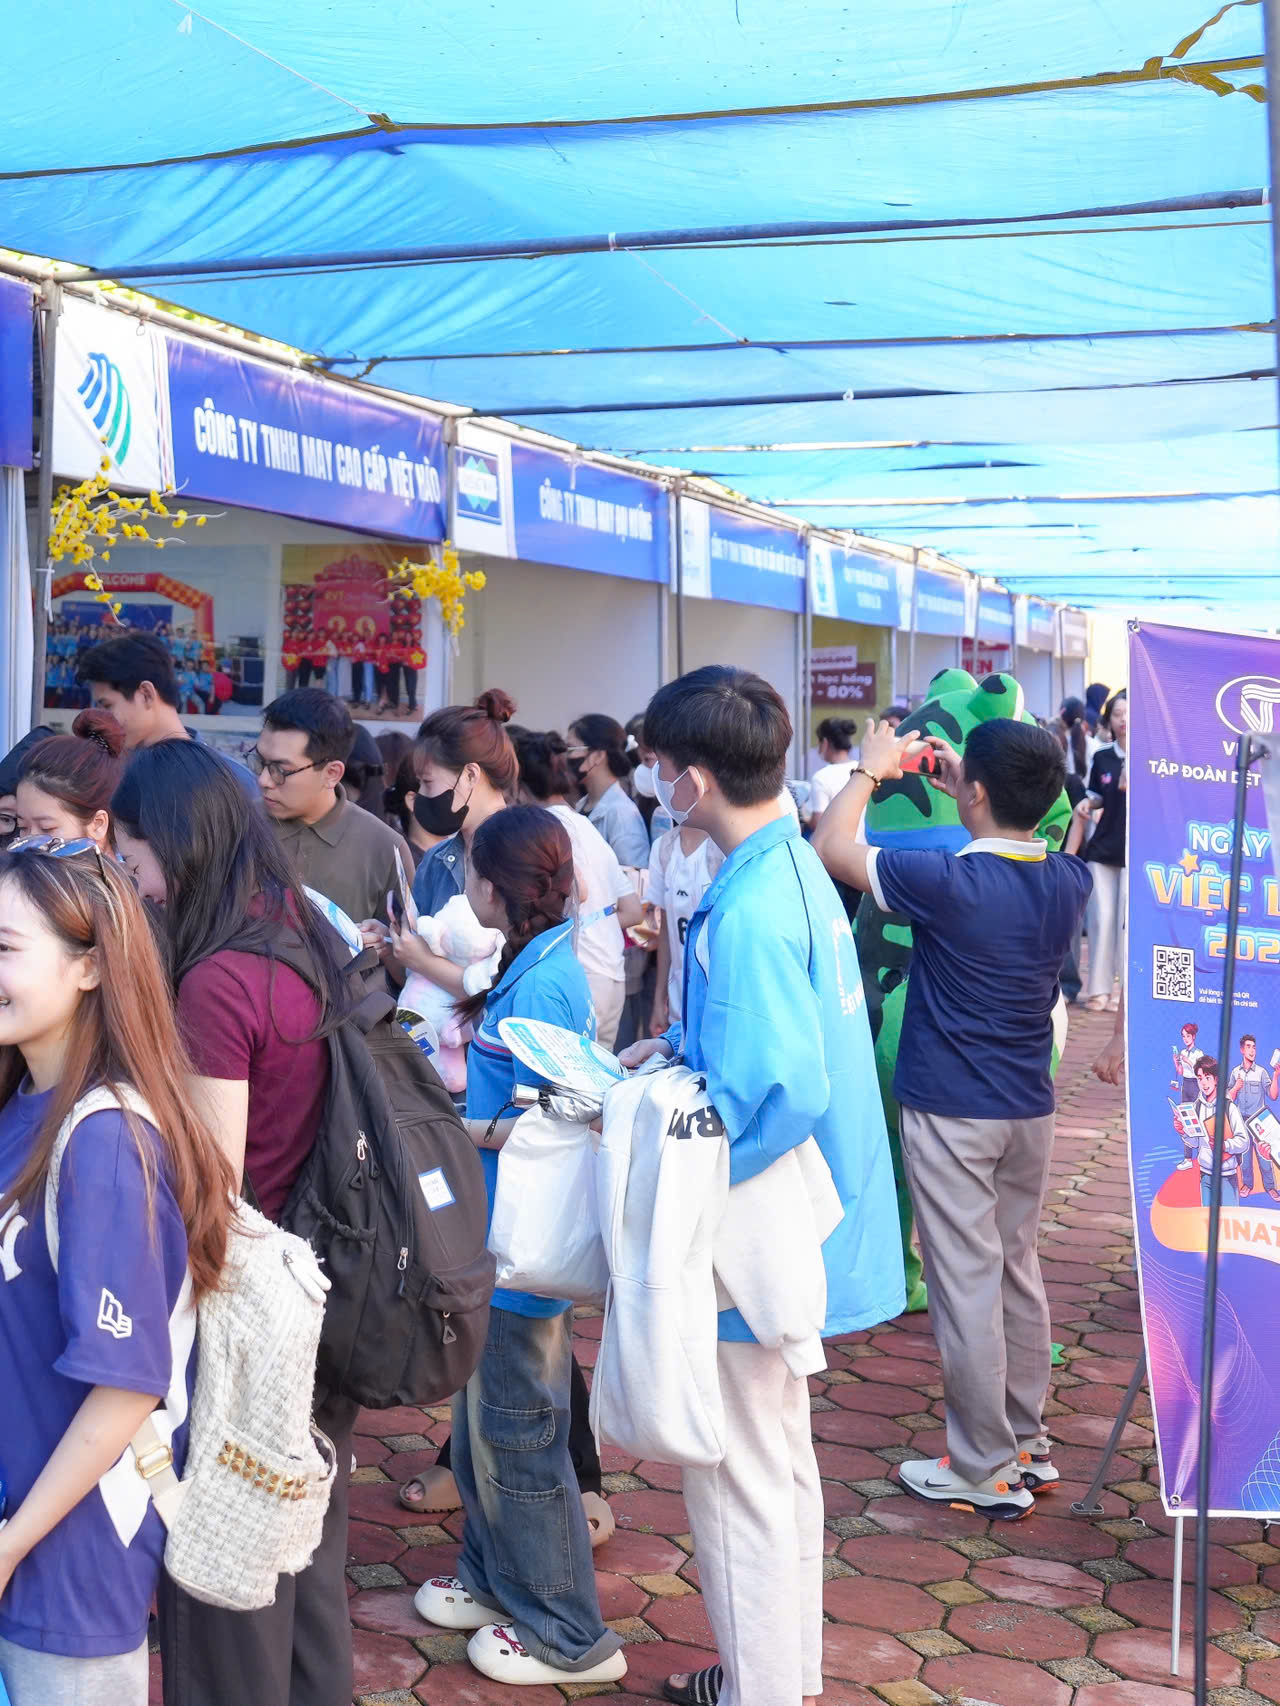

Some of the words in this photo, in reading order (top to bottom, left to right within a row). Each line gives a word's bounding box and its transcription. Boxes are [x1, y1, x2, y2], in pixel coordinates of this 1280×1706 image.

[194, 397, 238, 460] CÔNG
[239, 418, 258, 464] TY
[260, 423, 301, 475] TNHH
[301, 434, 333, 482] MAY
[335, 443, 363, 488] CAO
[363, 444, 388, 494] CẤP
[388, 451, 415, 507] VIỆT
[827, 685, 864, 699] 80%
[1149, 759, 1179, 778] TẬP
[1182, 765, 1227, 783] ĐOÀN
[1150, 864, 1248, 916] VIỆC
